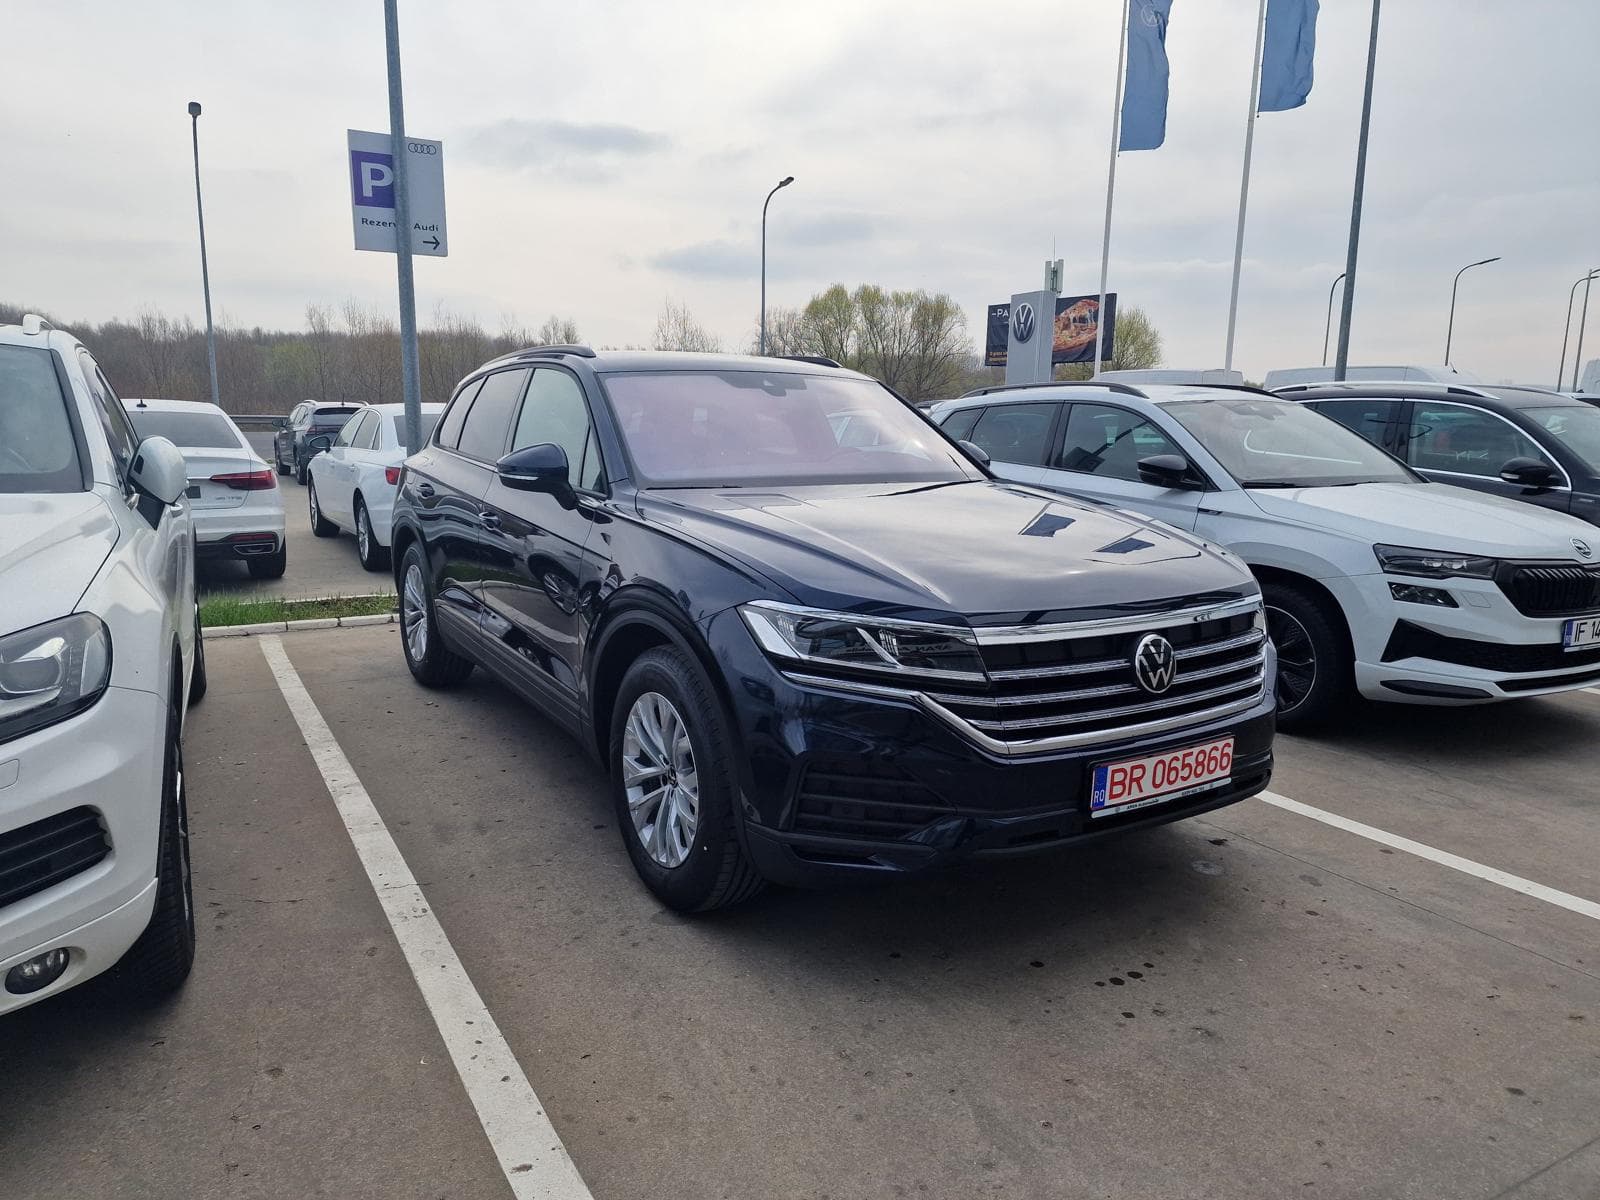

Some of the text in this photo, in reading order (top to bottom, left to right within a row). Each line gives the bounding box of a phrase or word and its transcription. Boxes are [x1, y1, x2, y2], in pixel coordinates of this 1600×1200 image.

[361, 161, 394, 197] P
[361, 217, 439, 232] Rezerv Audi
[1575, 621, 1588, 642] IF
[1108, 742, 1232, 800] BR 065866
[1094, 789, 1105, 803] RO
